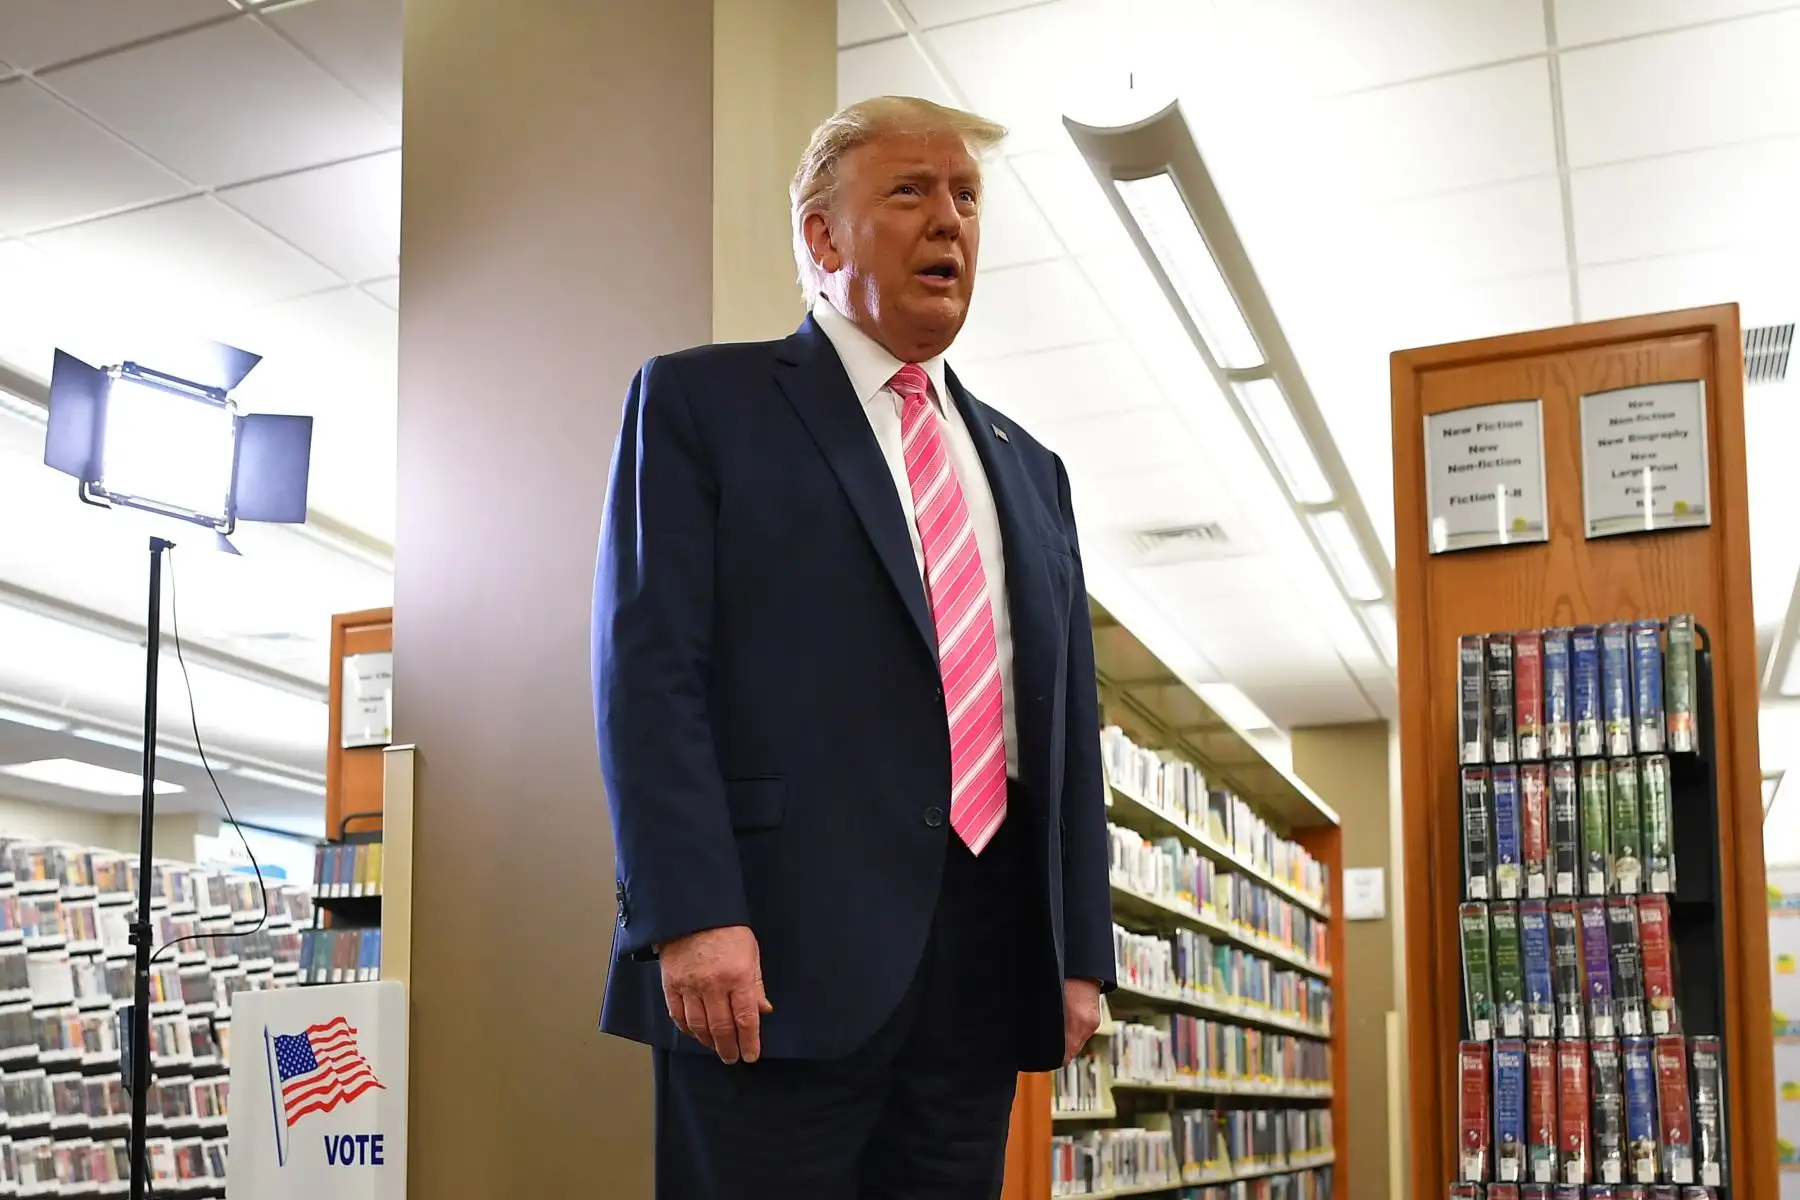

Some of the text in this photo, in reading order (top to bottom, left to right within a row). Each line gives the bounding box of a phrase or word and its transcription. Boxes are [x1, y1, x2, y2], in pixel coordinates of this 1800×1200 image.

[1628, 400, 1655, 408] New
[1443, 420, 1523, 438] New Fiction
[1598, 430, 1689, 447] New Biography
[1468, 445, 1498, 455] New
[1448, 458, 1522, 474] Non-fiction
[1450, 493, 1495, 506] Fiction
[324, 1134, 384, 1166] VOTE
